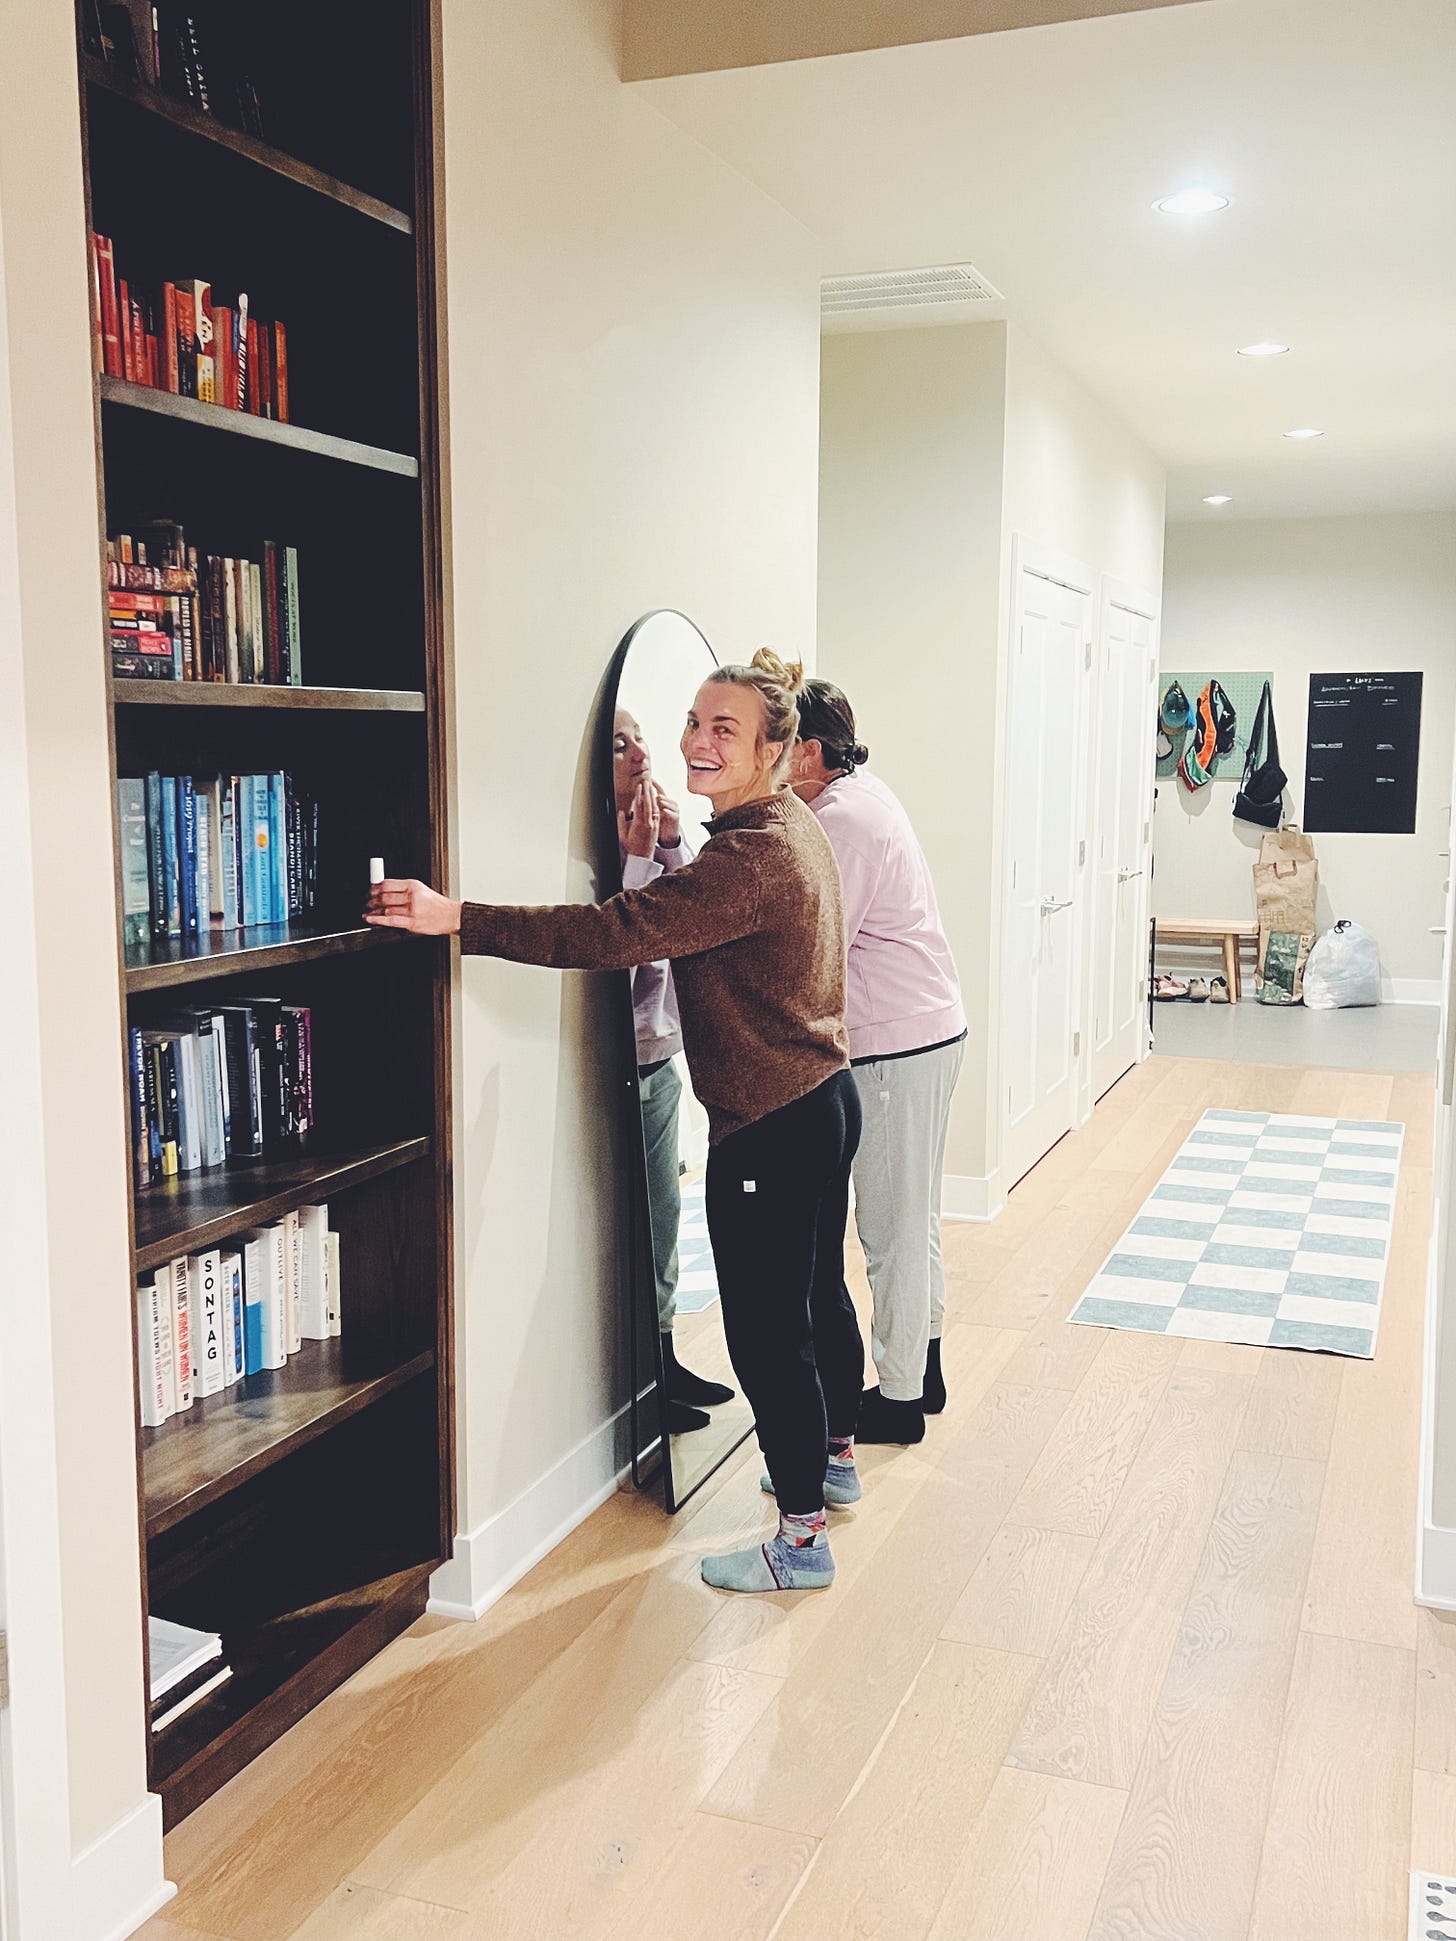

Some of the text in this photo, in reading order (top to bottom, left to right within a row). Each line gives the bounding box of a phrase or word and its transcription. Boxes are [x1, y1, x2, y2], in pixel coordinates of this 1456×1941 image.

[183, 796, 193, 818] 1619
[183, 821, 194, 853] Project
[200, 851, 208, 874] READ
[136, 1032, 144, 1071] TREVOR
[293, 1239, 299, 1254] WE
[205, 1260, 217, 1360] SONTAG
